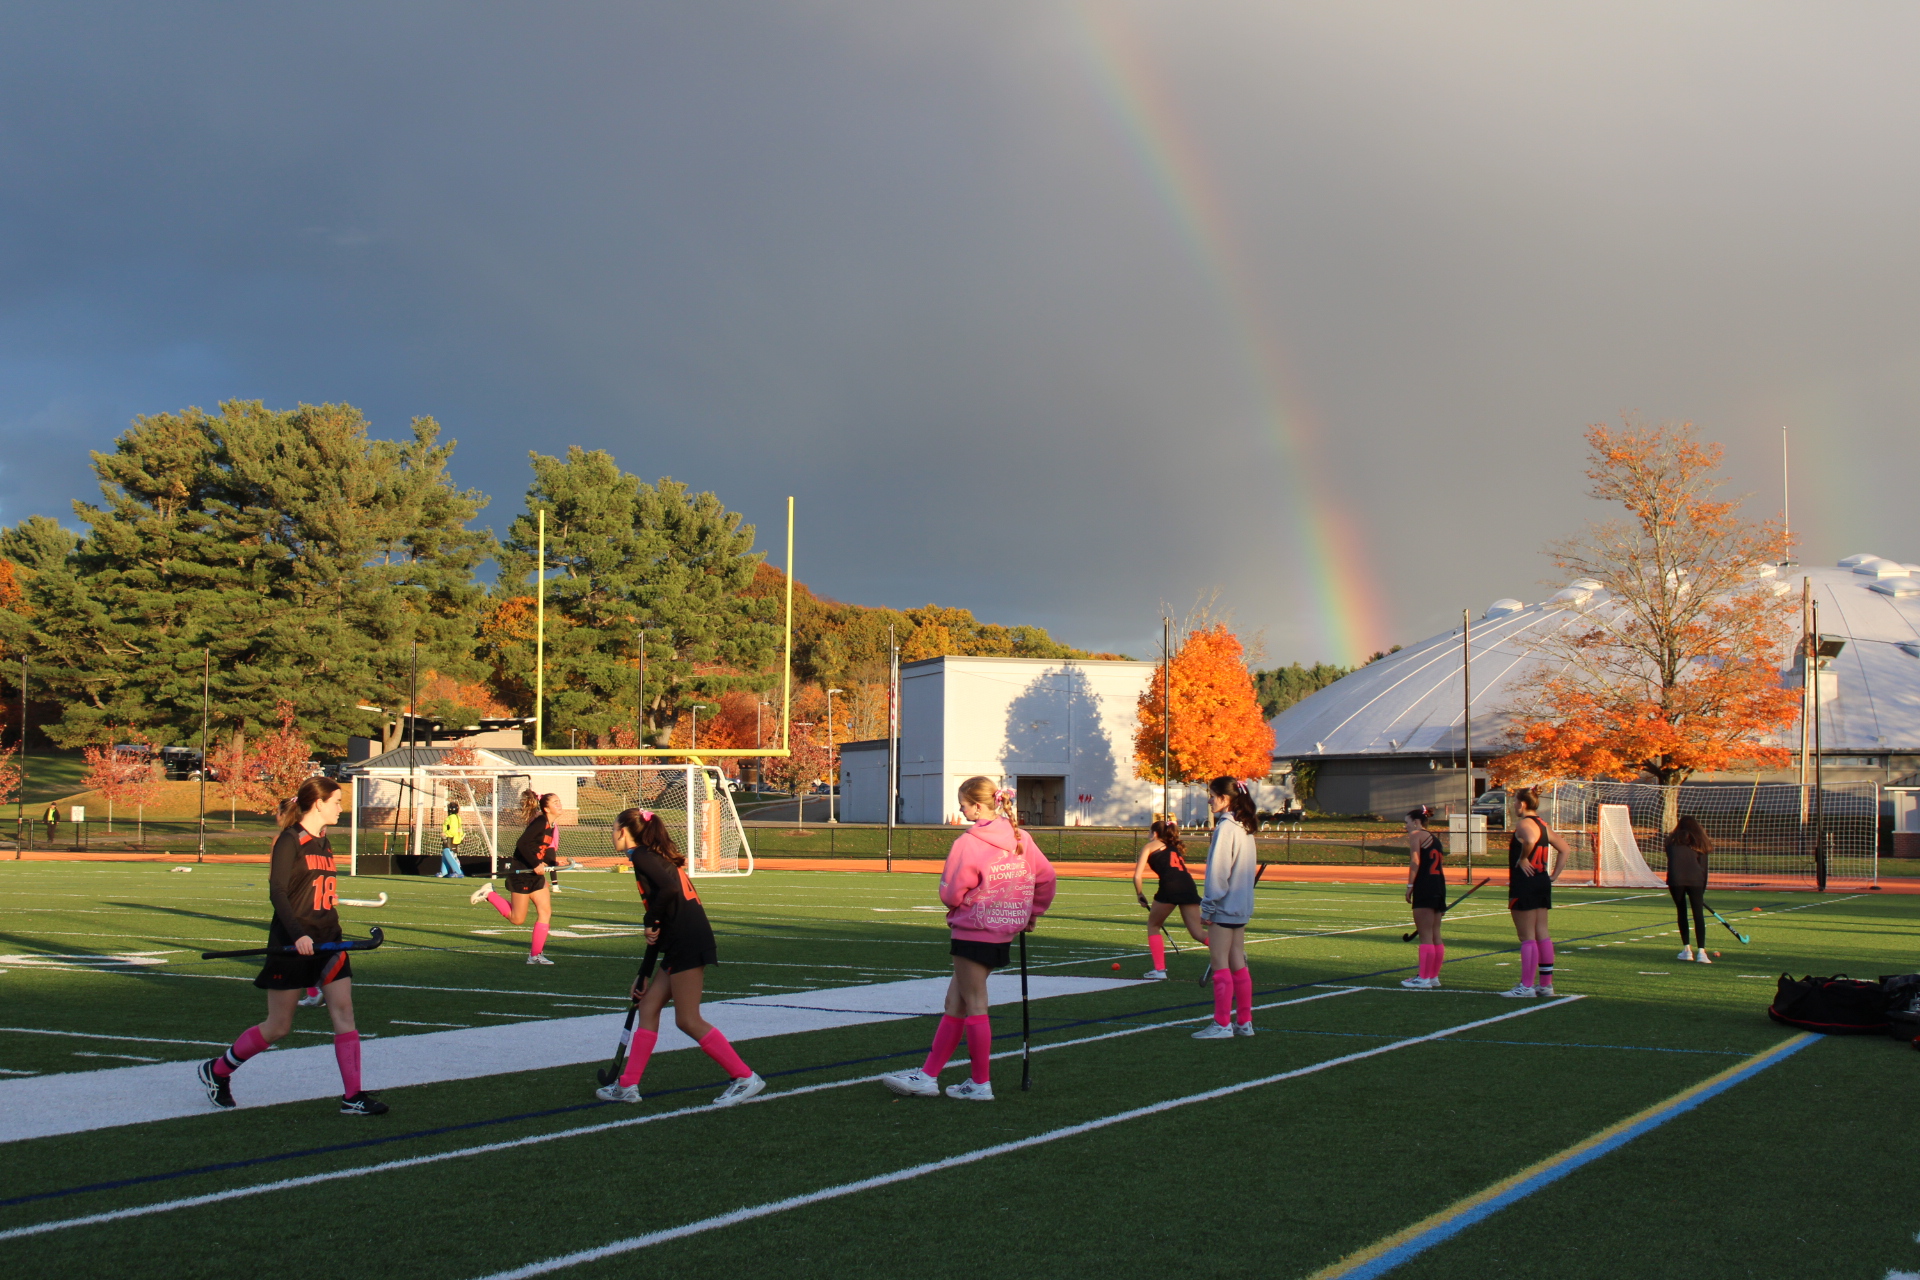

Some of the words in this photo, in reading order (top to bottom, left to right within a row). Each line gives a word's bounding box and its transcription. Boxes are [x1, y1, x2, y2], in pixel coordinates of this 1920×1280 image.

[312, 875, 337, 911] 18
[1003, 901, 1024, 909] DAILY
[991, 909, 1028, 917] SOUTHERN
[986, 916, 1025, 925] CALIFORNIA
